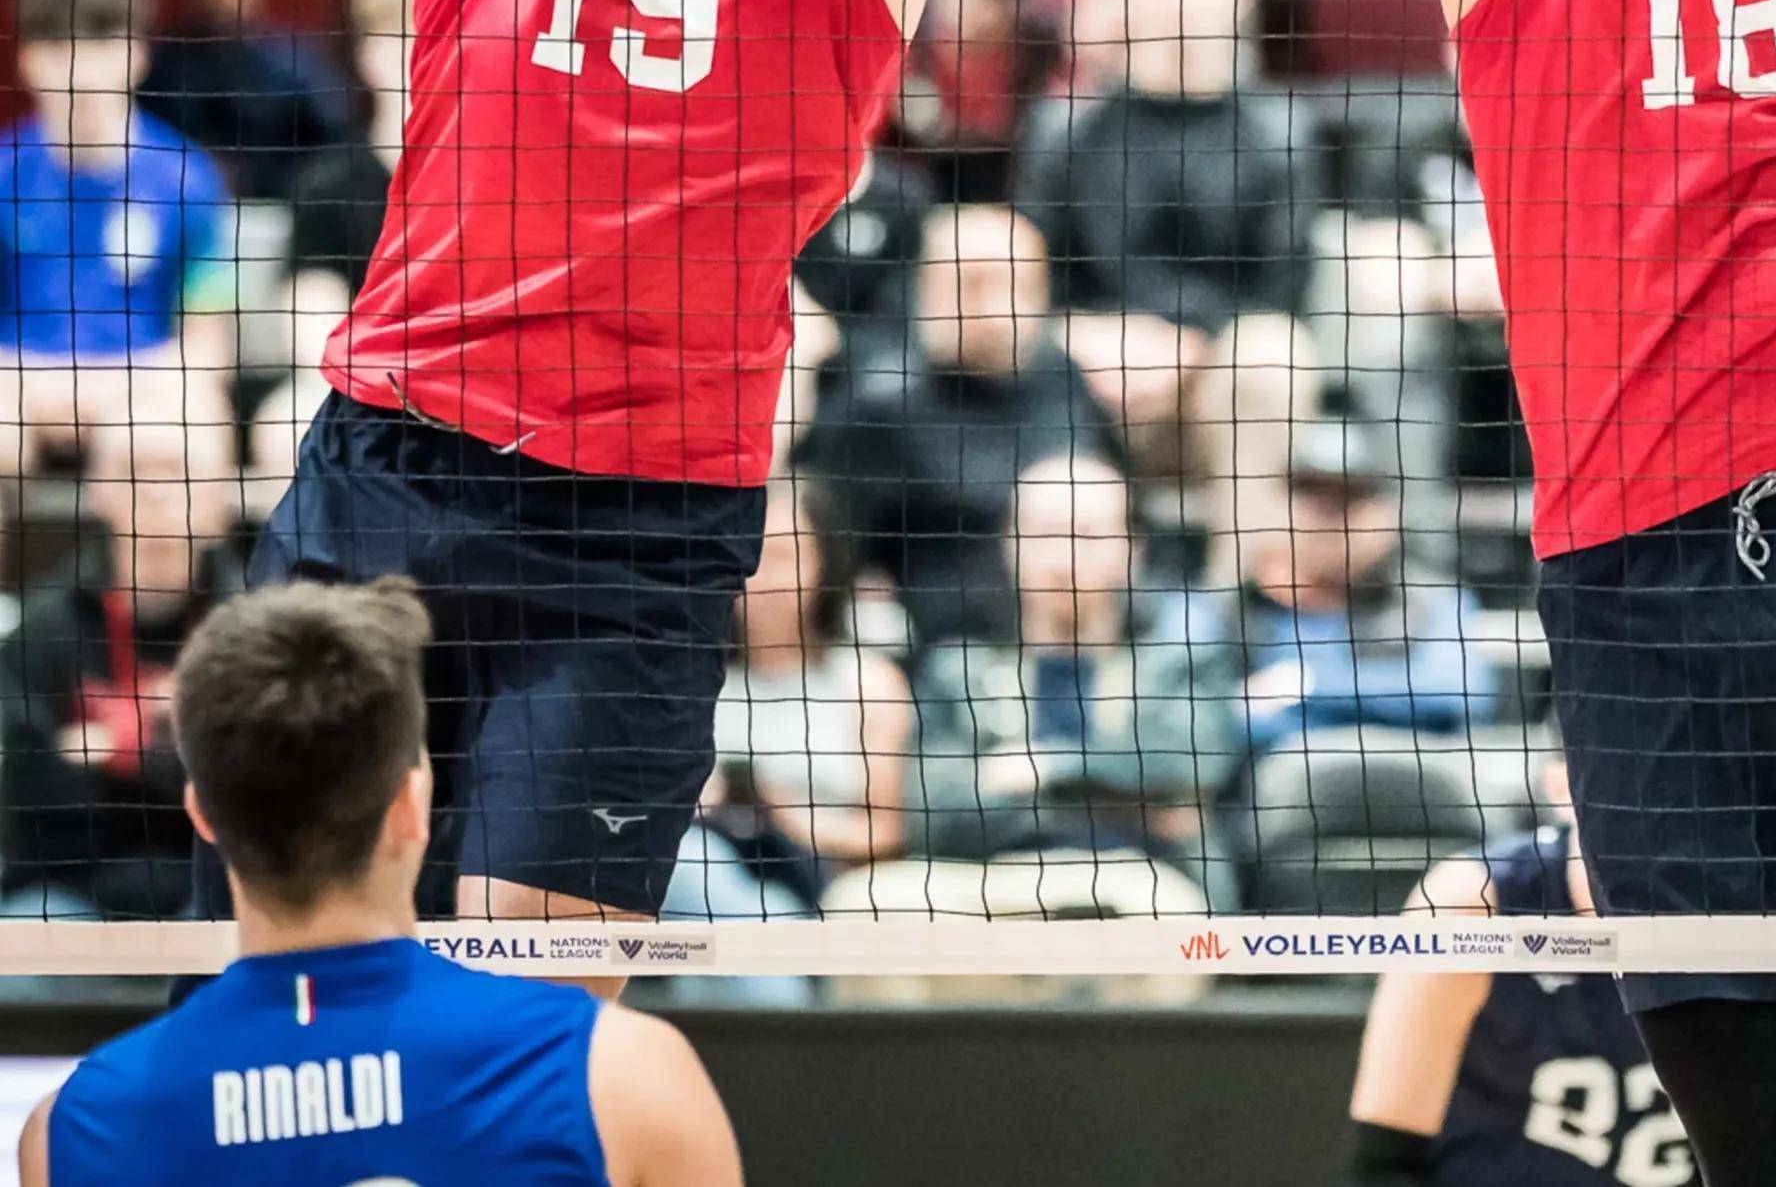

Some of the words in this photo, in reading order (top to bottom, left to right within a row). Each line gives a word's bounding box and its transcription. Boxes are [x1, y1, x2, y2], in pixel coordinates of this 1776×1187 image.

[550, 937, 610, 948] NATIONS
[1453, 933, 1513, 943] NATIONS
[1552, 937, 1611, 948] Volleyball
[648, 940, 708, 951] Volleyball
[1180, 931, 1231, 960] VNL
[1242, 934, 1447, 956] VOLLEYBALL
[1453, 944, 1504, 954] LEAGUE
[550, 949, 602, 959] LEAGUE
[648, 951, 688, 960] World
[1552, 947, 1591, 955] World
[212, 1050, 404, 1147] RINALDI
